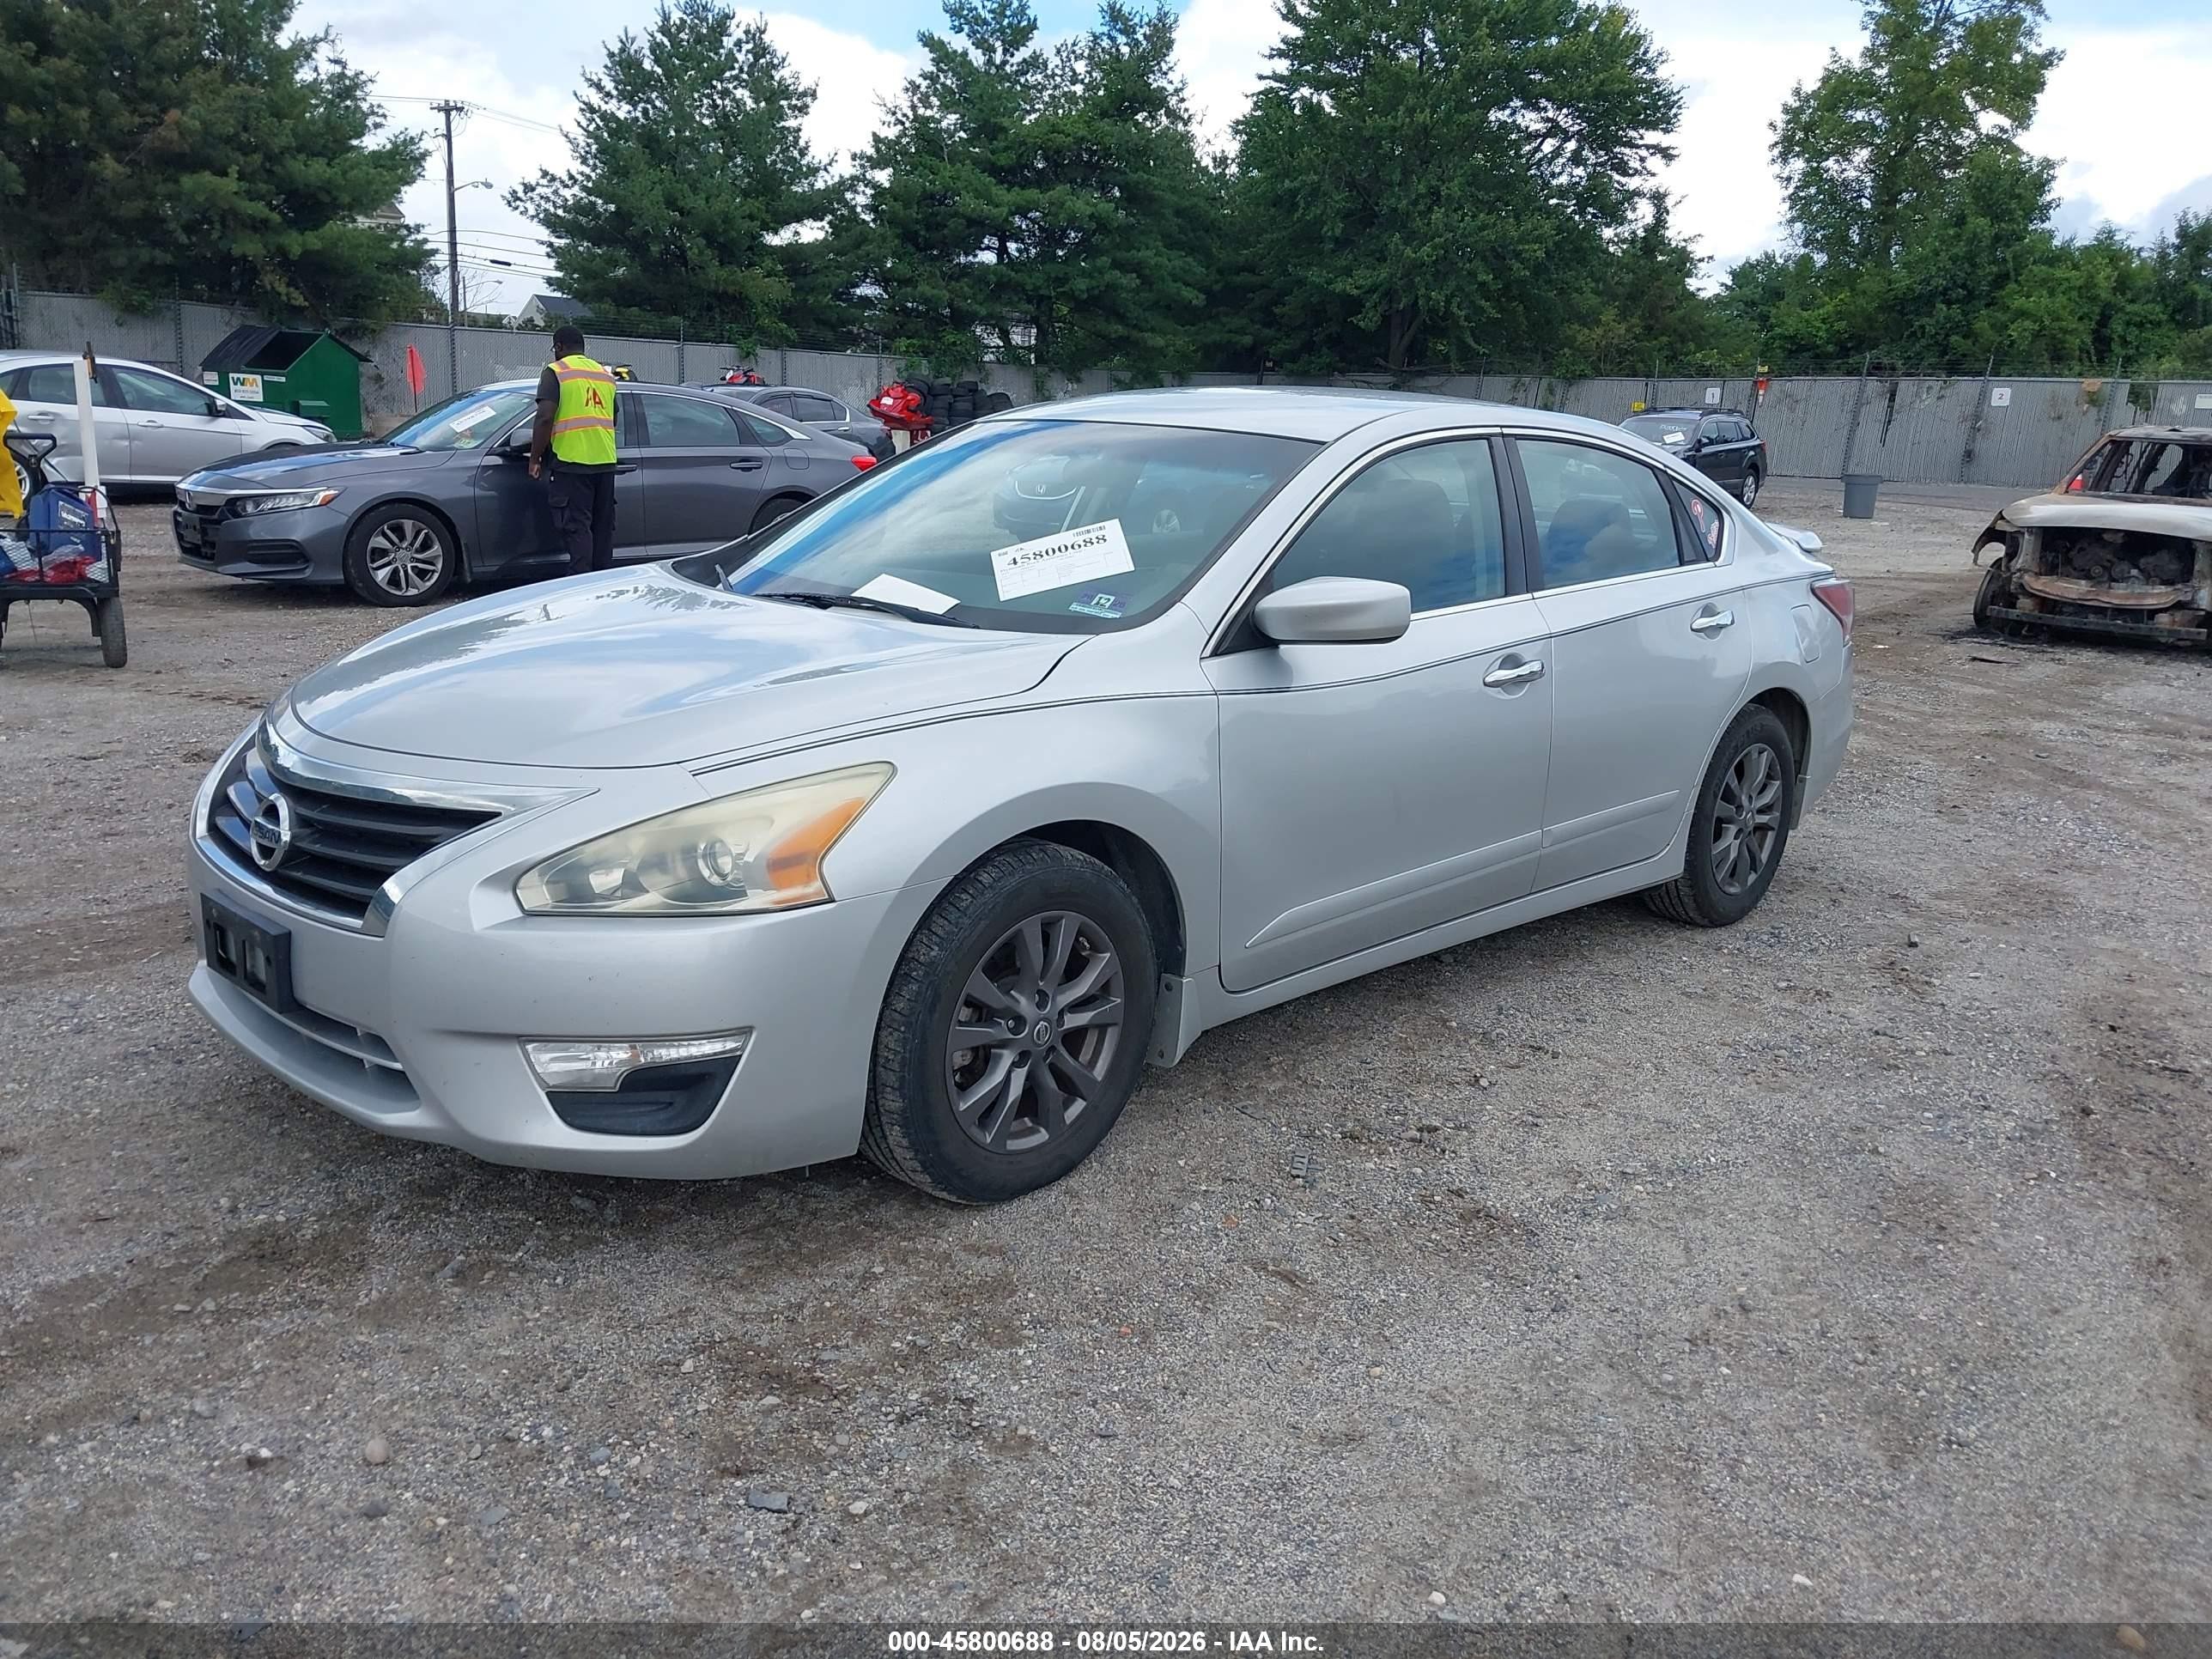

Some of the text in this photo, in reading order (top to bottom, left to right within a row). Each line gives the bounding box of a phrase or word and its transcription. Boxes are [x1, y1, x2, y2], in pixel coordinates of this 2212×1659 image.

[231, 376, 258, 387] WM
[1007, 534, 1108, 566] 45800688
[1095, 596, 1111, 607] 12
